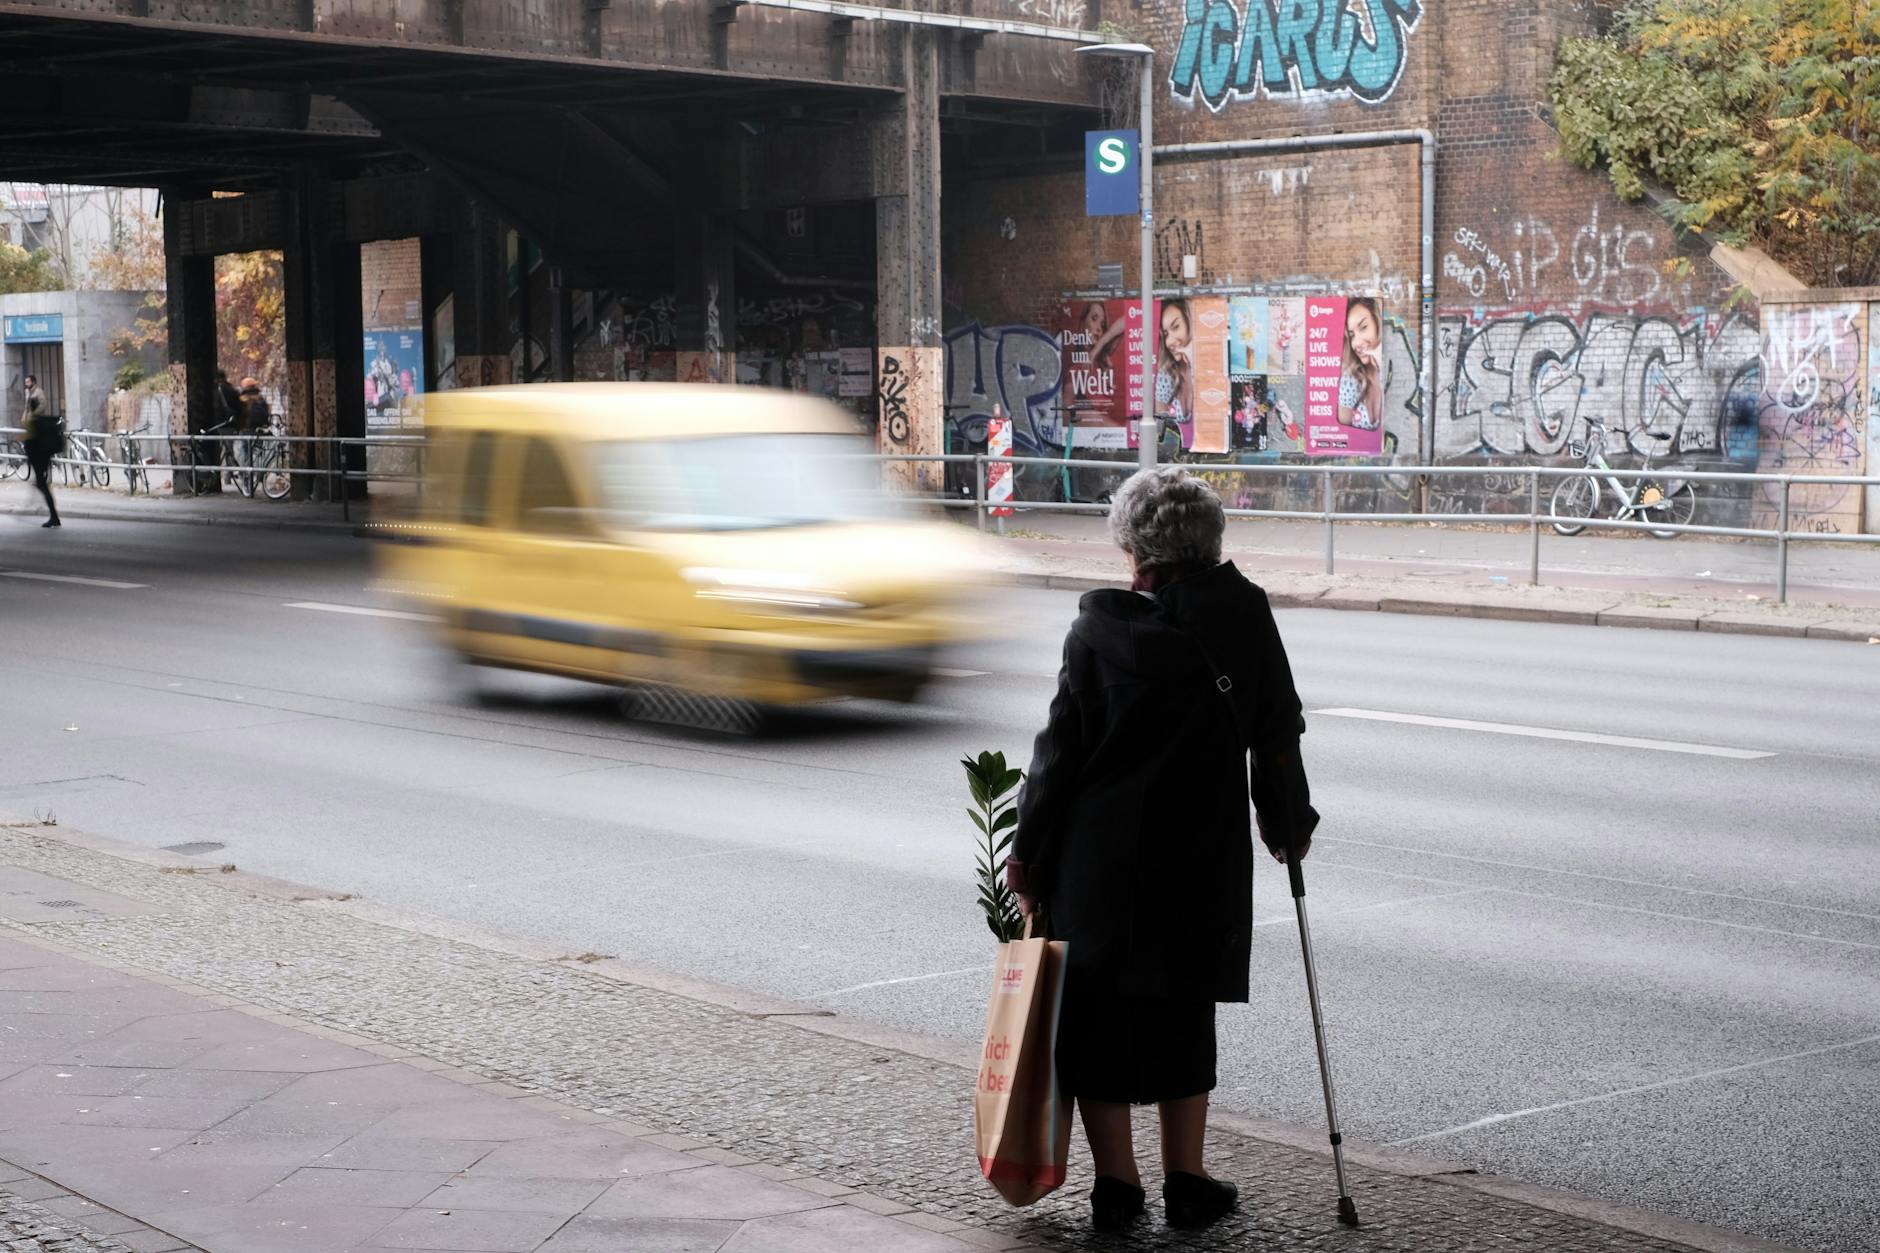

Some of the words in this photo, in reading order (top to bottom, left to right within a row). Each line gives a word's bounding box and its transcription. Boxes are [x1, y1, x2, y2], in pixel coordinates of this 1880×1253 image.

[1099, 138, 1126, 174] S
[5, 319, 11, 337] U
[1309, 327, 1328, 339] 24/7
[1064, 328, 1093, 346] Denk
[1309, 341, 1328, 353] LIVE
[1071, 351, 1090, 364] um
[1309, 356, 1341, 367] SHOWS
[1069, 367, 1115, 396] Welt!
[1231, 374, 1244, 384] 100
[1309, 376, 1340, 388] PRIVAT
[1309, 390, 1329, 402] UND
[1309, 404, 1333, 416] HEISS
